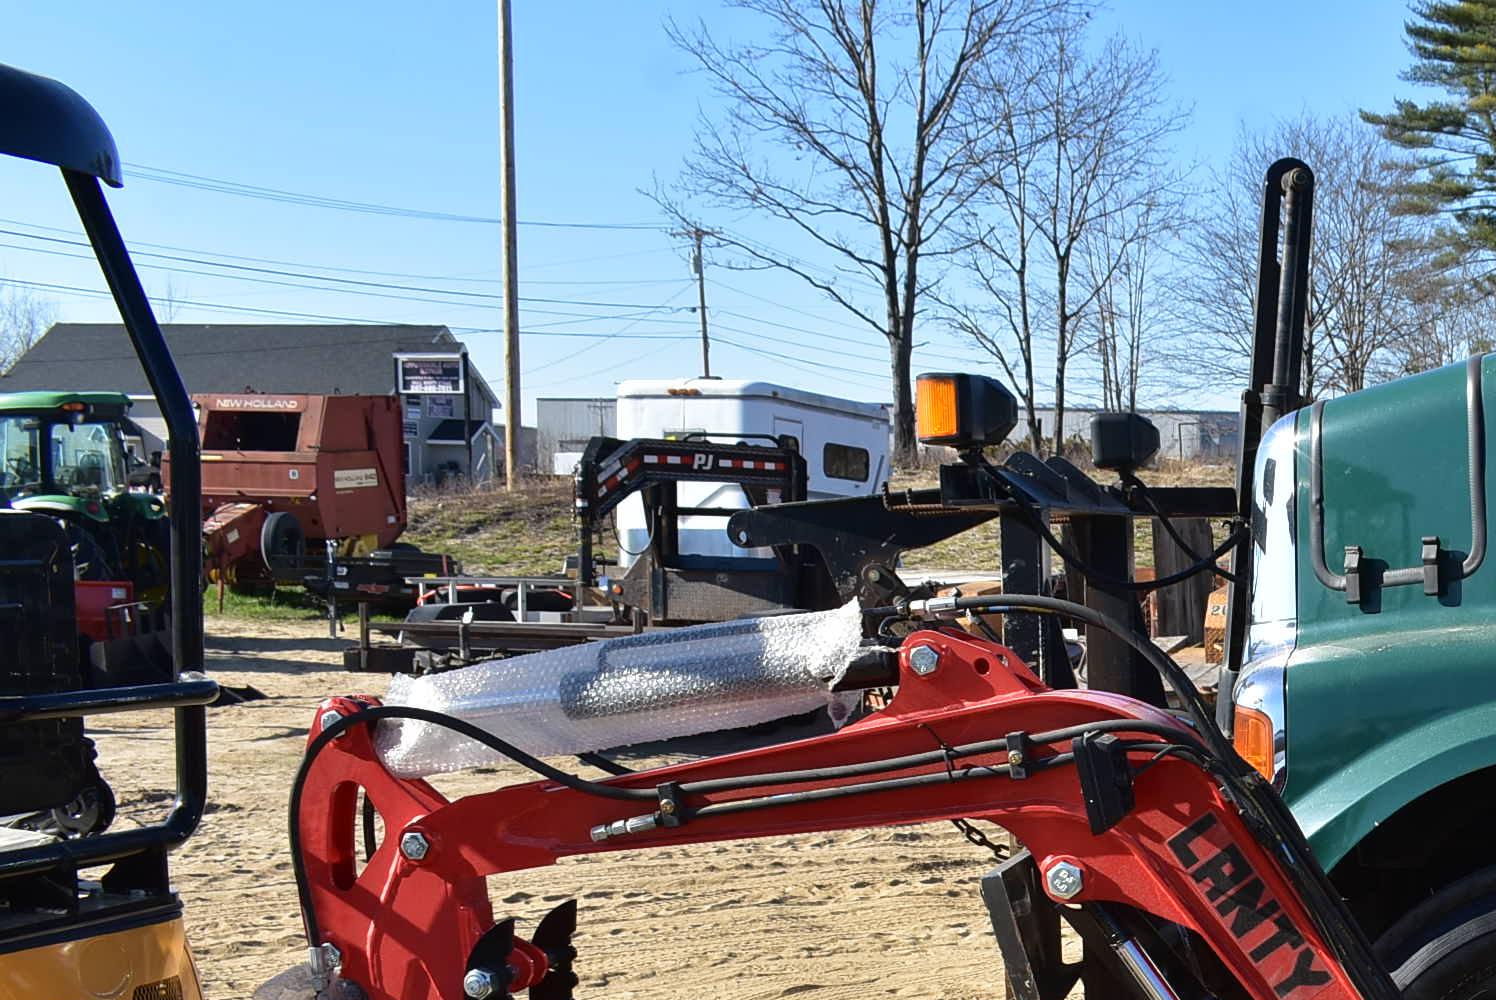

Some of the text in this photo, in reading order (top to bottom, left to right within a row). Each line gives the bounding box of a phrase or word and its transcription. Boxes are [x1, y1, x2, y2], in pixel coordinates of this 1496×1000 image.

[216, 399, 298, 409] NEW HOLLAND
[692, 453, 714, 470] PJ
[1167, 811, 1334, 999] LANTY
